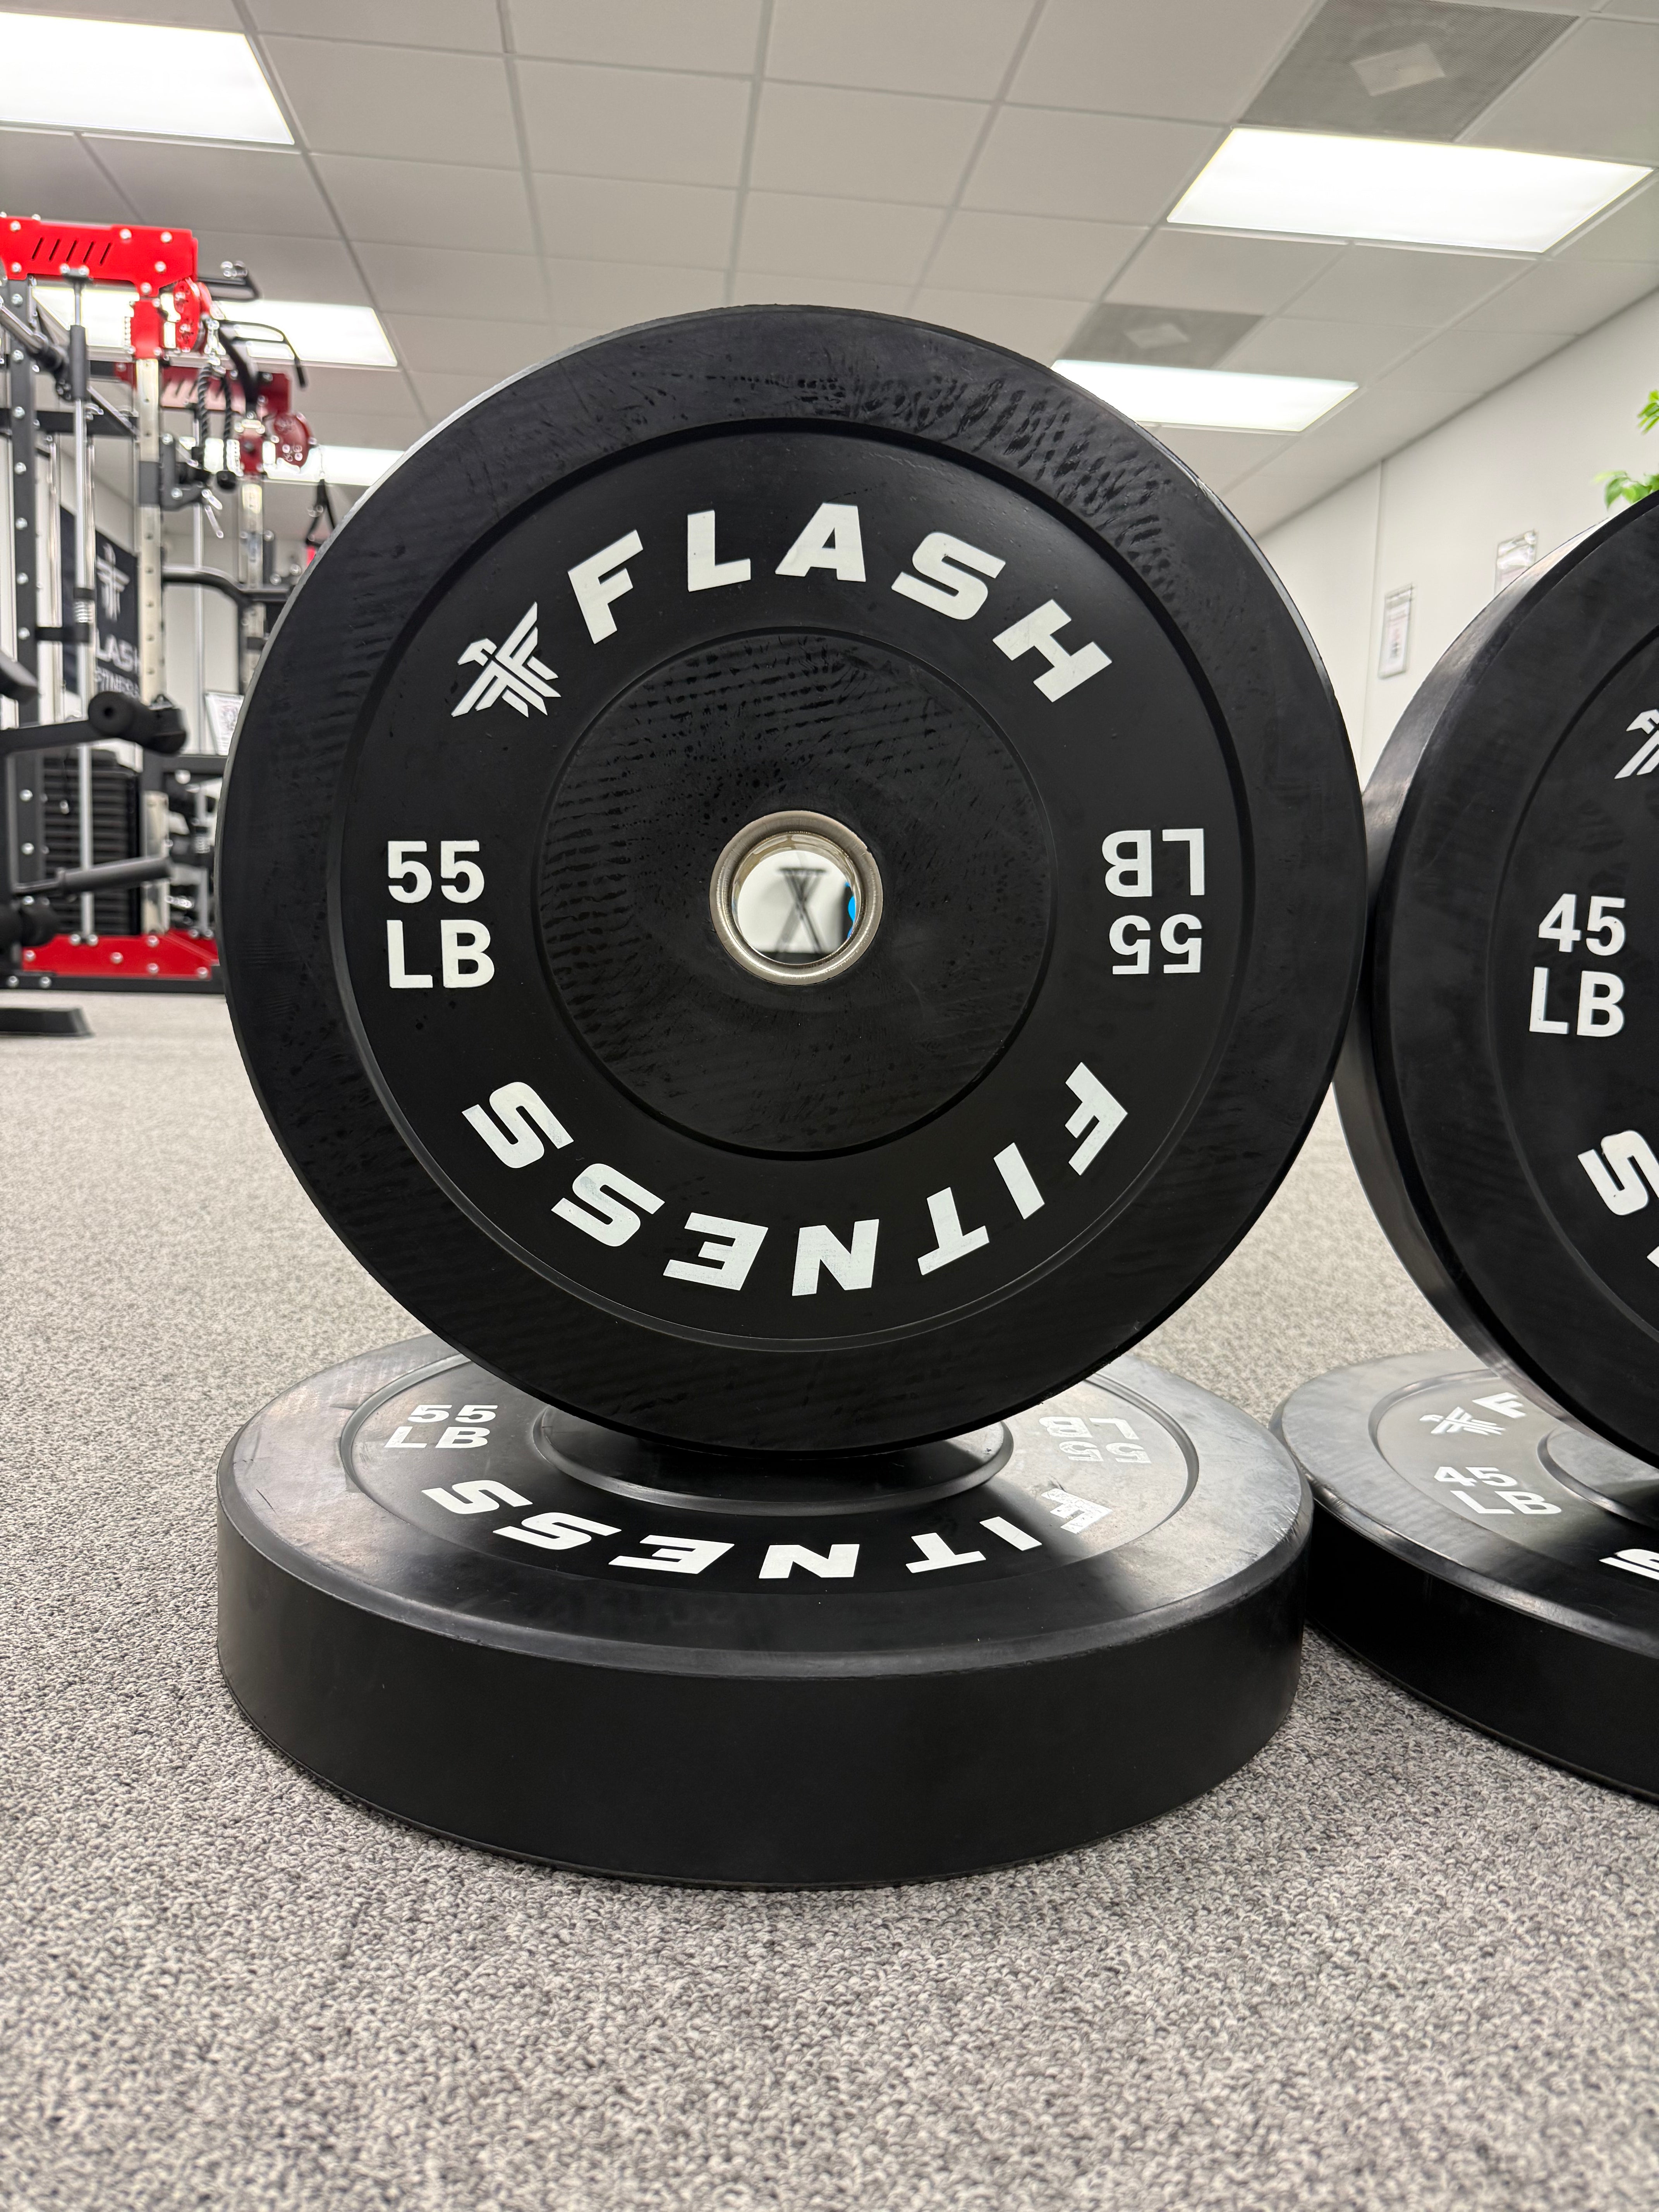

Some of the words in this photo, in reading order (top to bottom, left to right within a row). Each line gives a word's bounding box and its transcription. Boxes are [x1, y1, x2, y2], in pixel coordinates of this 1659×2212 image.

[568, 503, 1112, 702] FLASH
[388, 840, 484, 903] 55
[1102, 828, 1205, 897] LB
[386, 919, 495, 988] LB
[1109, 914, 1202, 975] 55
[1538, 893, 1625, 956] 45
[1529, 967, 1624, 1037] LB
[462, 1062, 1128, 1296] FITNESS
[384, 1426, 491, 1448] LB
[407, 1405, 498, 1423] 55
[1039, 1416, 1139, 1440] LB
[1059, 1441, 1151, 1463] 55
[1434, 1466, 1518, 1487] 45
[421, 1480, 1113, 1579] FITNESS
[1450, 1490, 1562, 1514] LB
